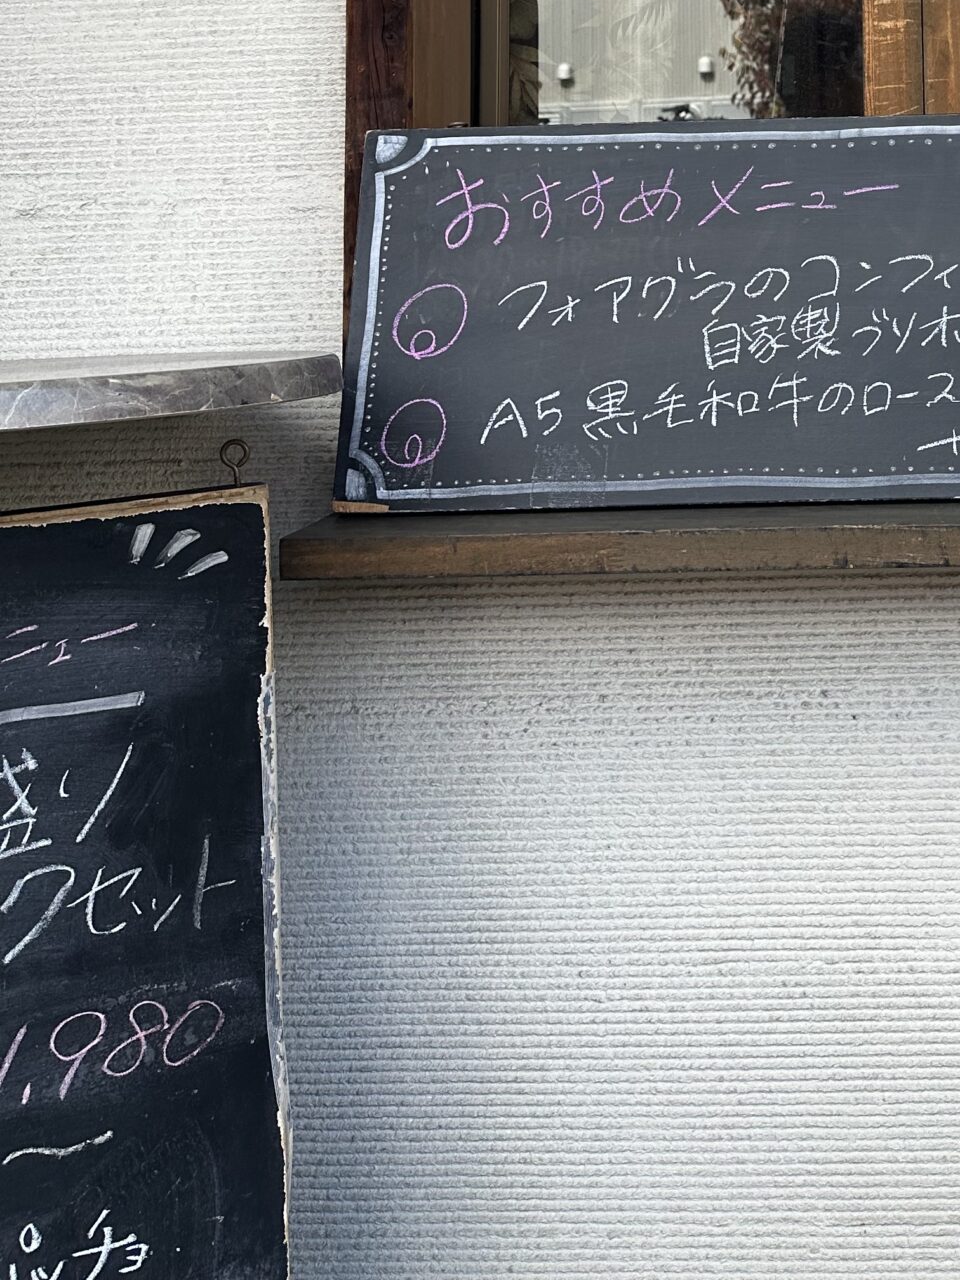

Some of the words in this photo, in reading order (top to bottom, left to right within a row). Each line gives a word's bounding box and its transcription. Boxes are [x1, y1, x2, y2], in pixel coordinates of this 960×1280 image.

[436, 165, 900, 251] おすすめメニュー
[497, 253, 960, 331] フォアグラのコンフィ
